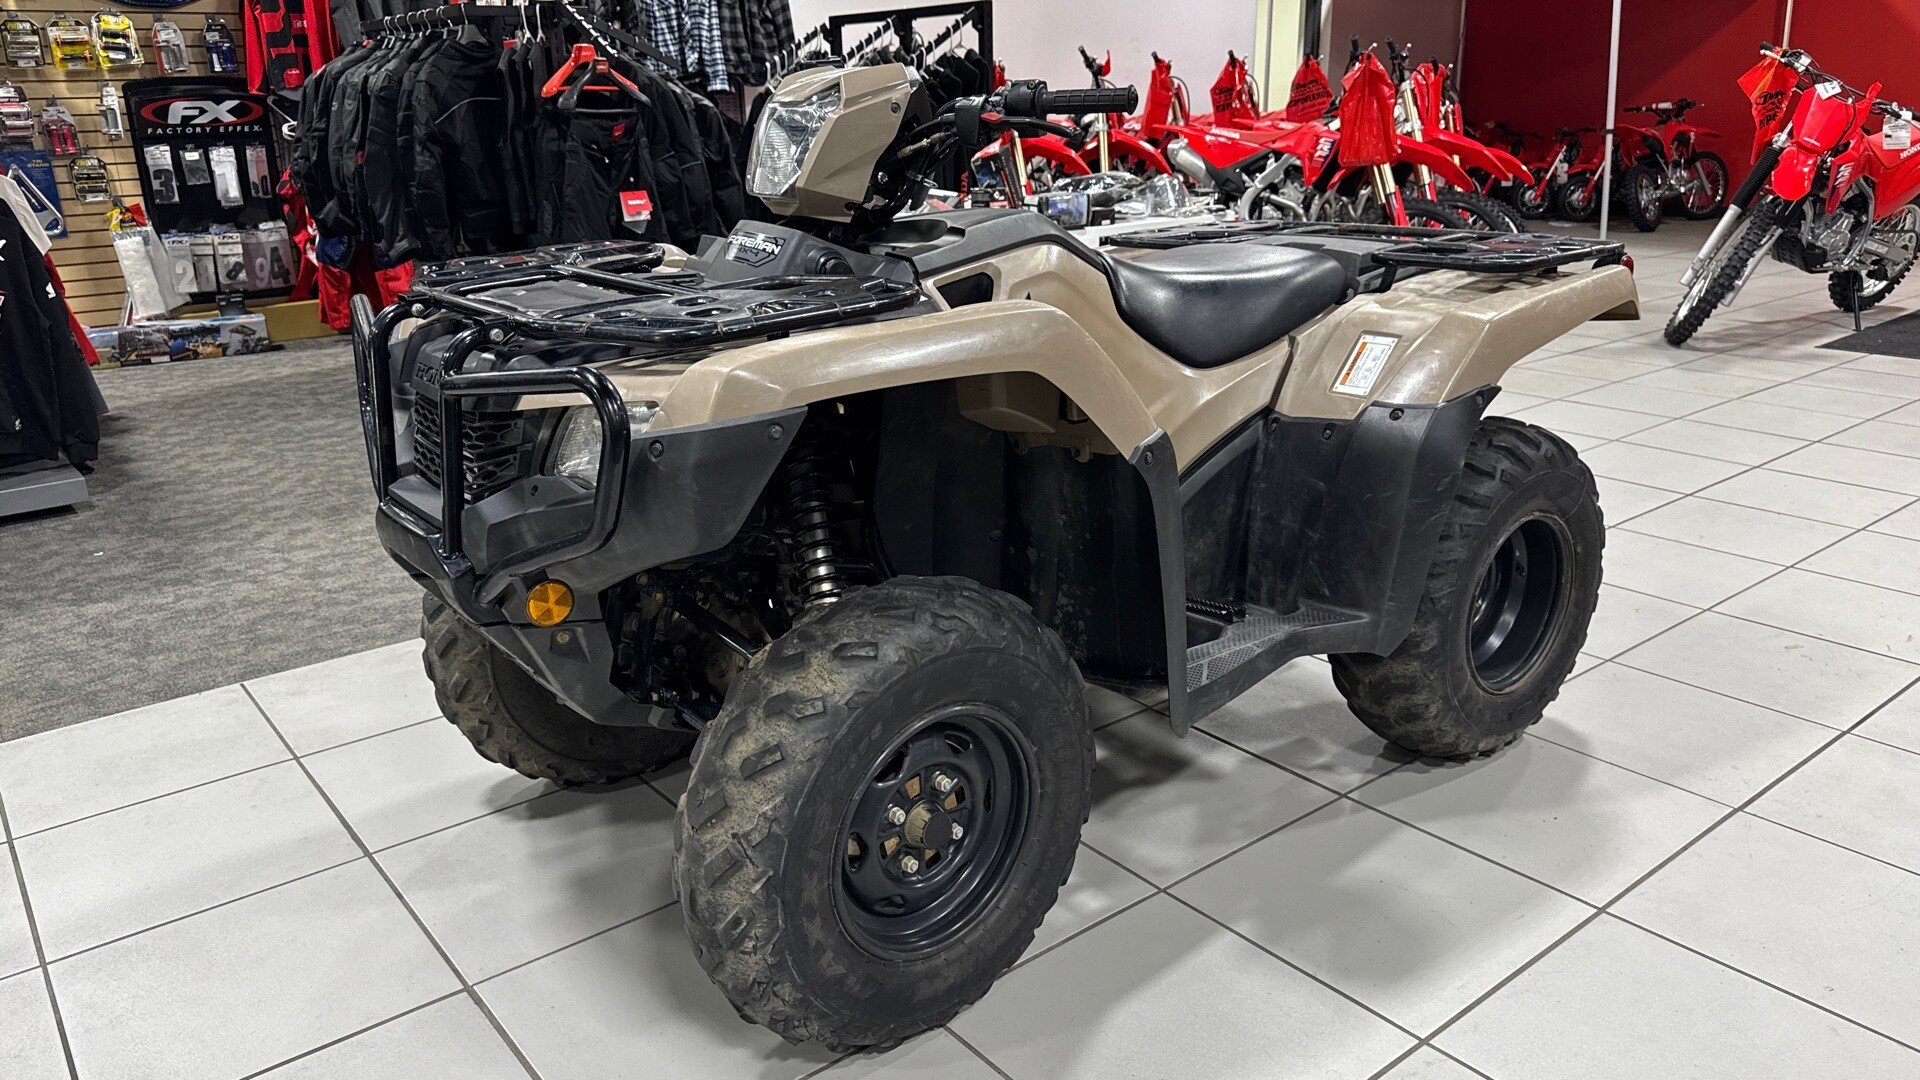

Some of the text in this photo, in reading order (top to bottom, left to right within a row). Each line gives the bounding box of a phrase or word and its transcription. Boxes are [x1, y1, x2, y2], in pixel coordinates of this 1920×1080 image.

[167, 99, 241, 125] FX
[147, 126, 212, 134] FACTORY
[152, 168, 176, 202] 3
[727, 234, 782, 255] FOREMAN
[175, 260, 194, 293] 2
[269, 245, 291, 285] 4
